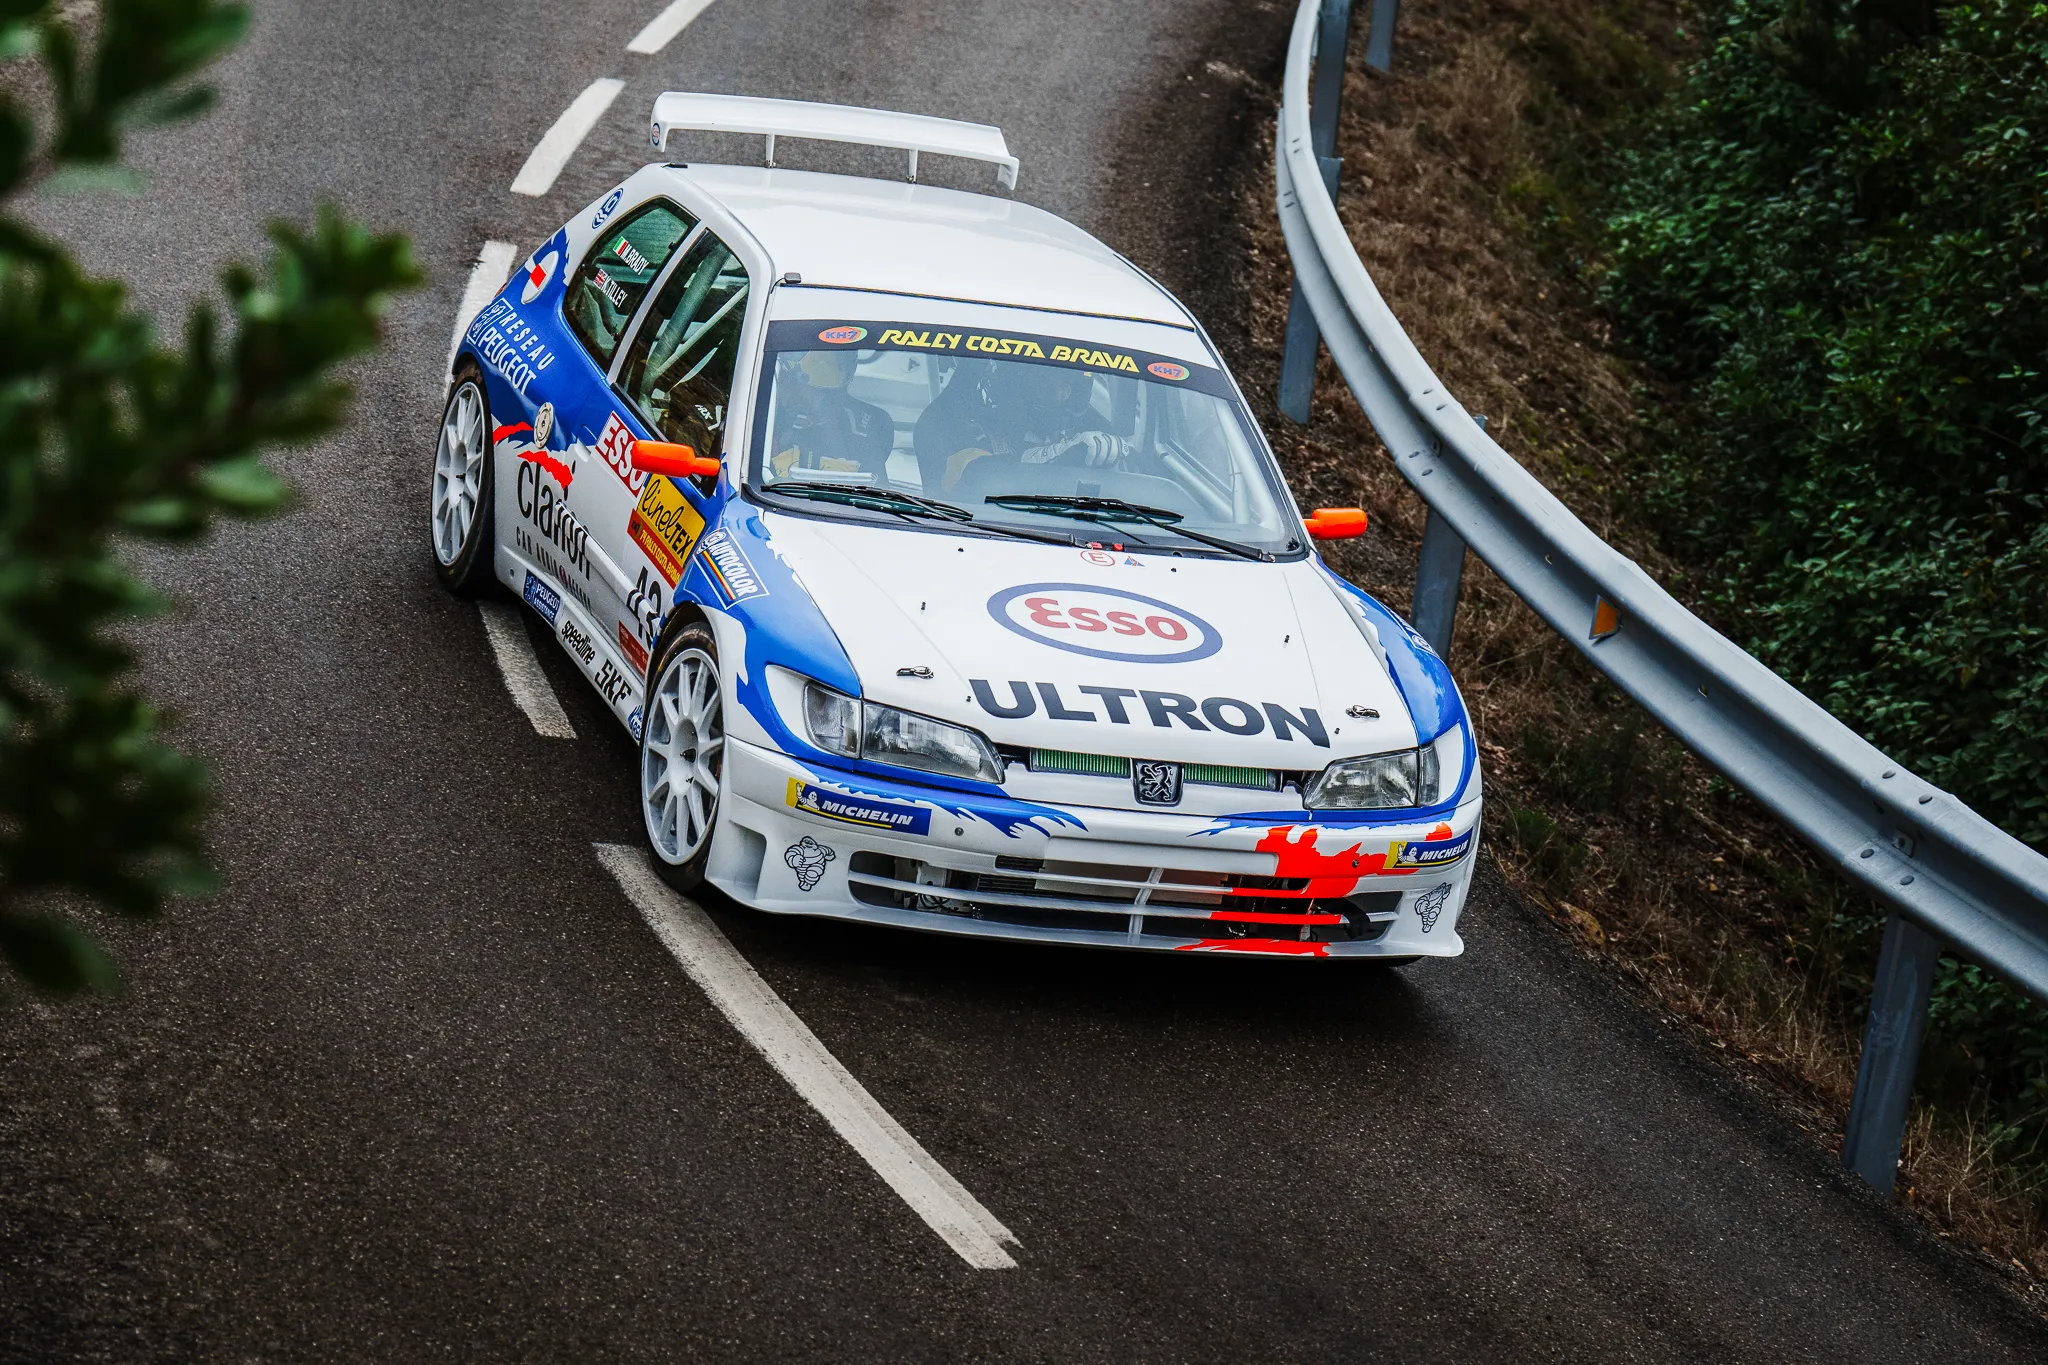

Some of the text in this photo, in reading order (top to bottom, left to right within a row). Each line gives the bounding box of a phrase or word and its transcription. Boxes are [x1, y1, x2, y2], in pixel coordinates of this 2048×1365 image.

[620, 244, 649, 275] M.BRADY
[478, 326, 537, 395] PEUGEOT
[499, 312, 555, 370] RESEAU
[877, 329, 1141, 373] RALLY COSTA BRAVA
[1153, 364, 1182, 378] KH7
[708, 541, 759, 598] AUTOCOLOR
[535, 582, 560, 611] PEUGEOT
[561, 620, 596, 665] speedline
[594, 658, 632, 706] SKF
[969, 679, 1331, 749] ULTRON
[821, 800, 914, 825] MICHELIN
[1418, 840, 1469, 862] MICHELIN
